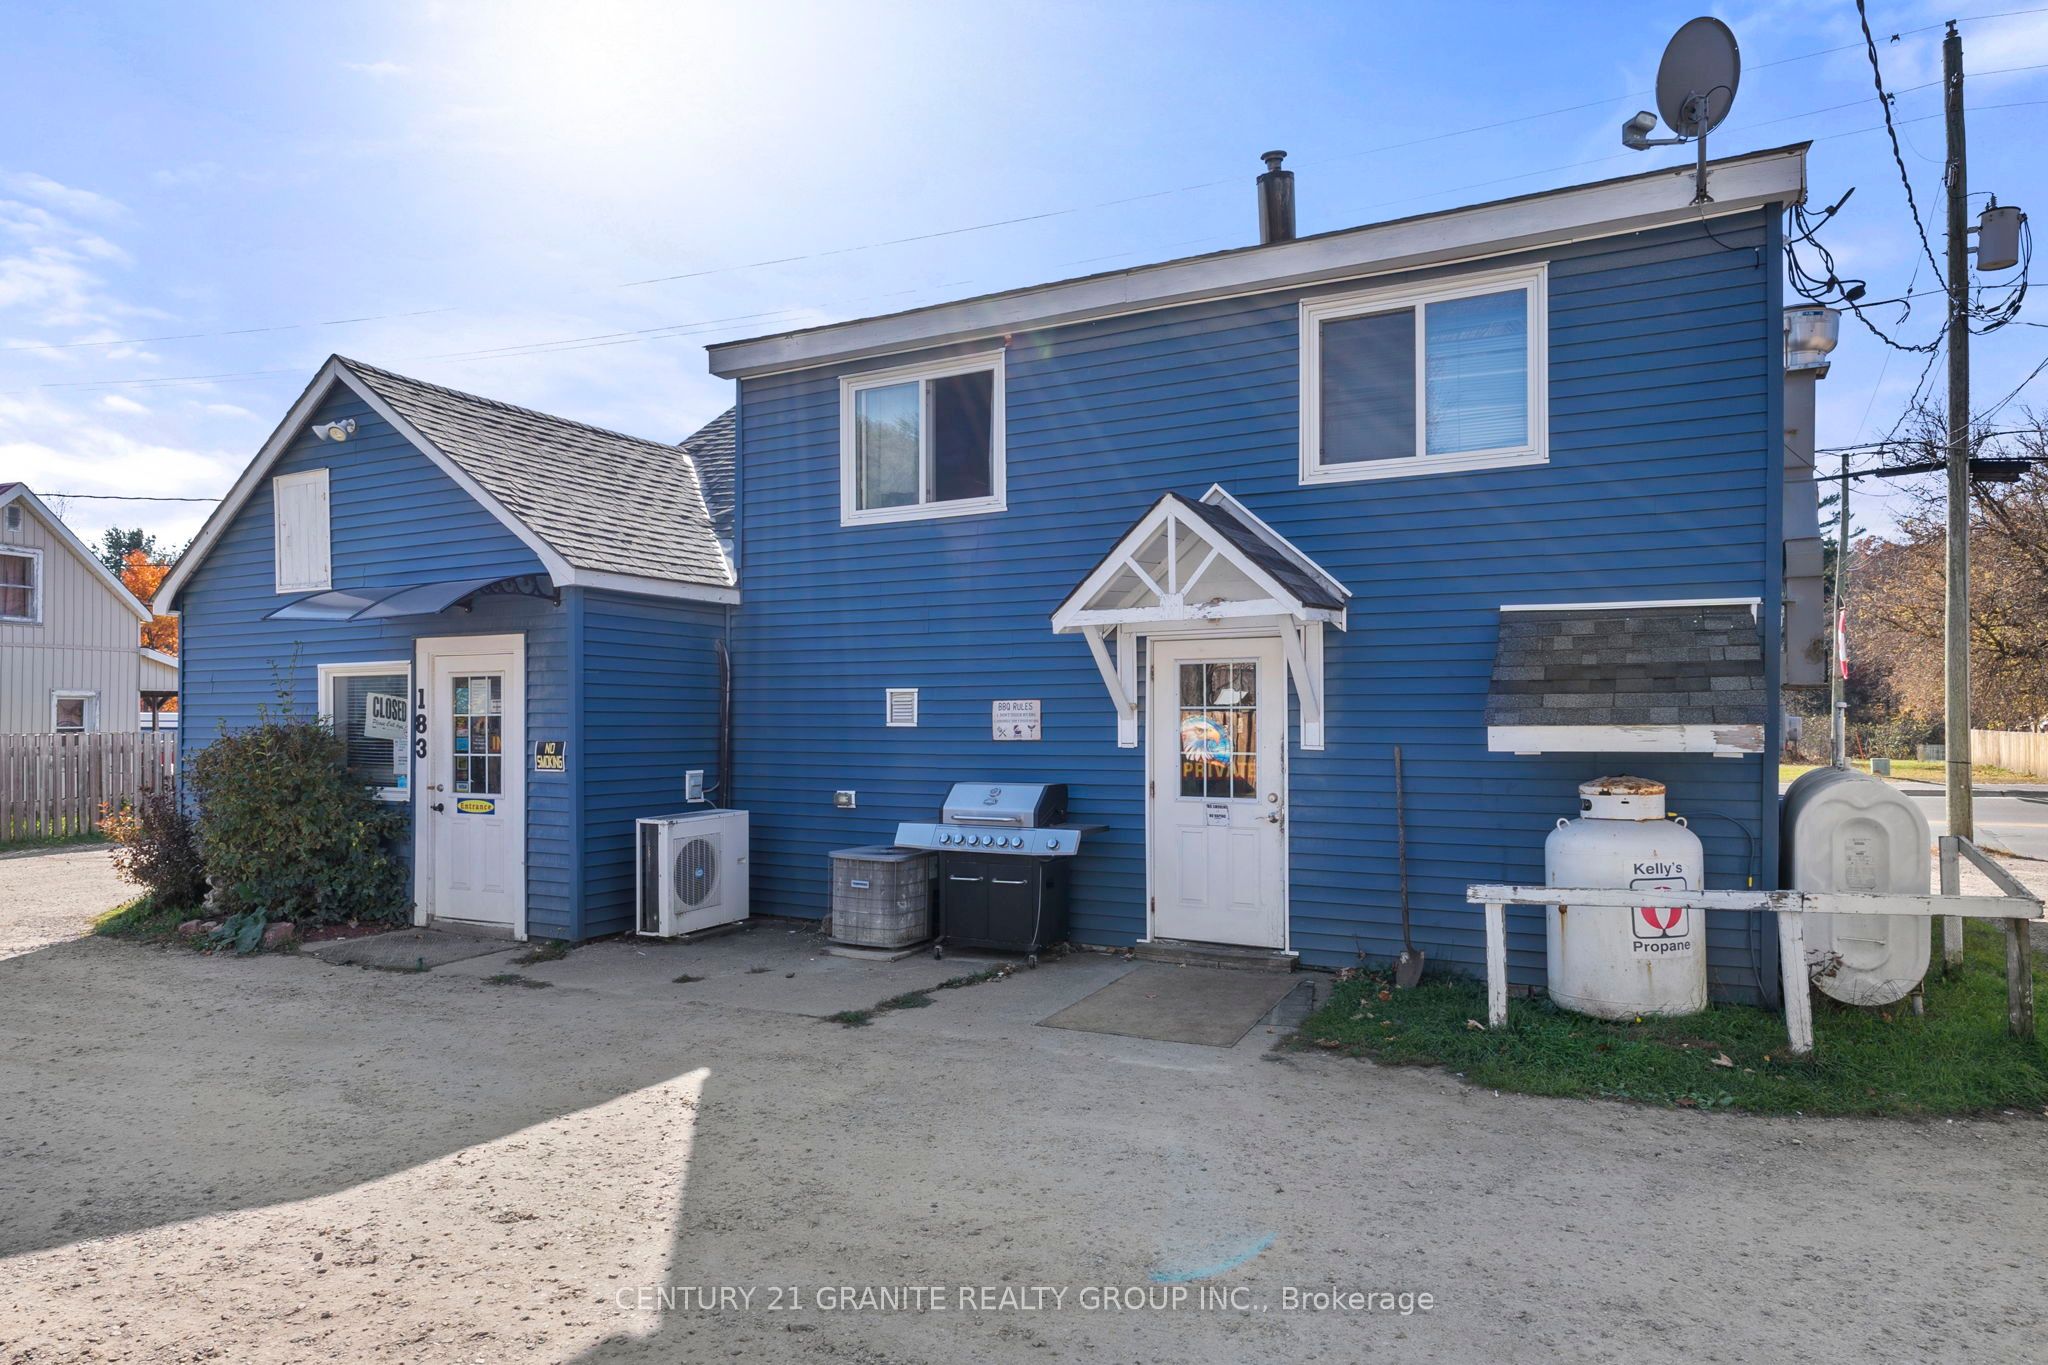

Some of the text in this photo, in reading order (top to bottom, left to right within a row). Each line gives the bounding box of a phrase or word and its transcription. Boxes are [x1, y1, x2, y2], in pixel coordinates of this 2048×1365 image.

[373, 696, 407, 722] CLOSED
[998, 702, 1032, 711] BBQ RULES
[415, 688, 427, 759] 183
[544, 742, 556, 755] NO
[537, 755, 562, 768] SMOKING
[460, 802, 492, 811] Entrance
[1633, 862, 1683, 877] Kelly's
[1633, 941, 1691, 955] Propane
